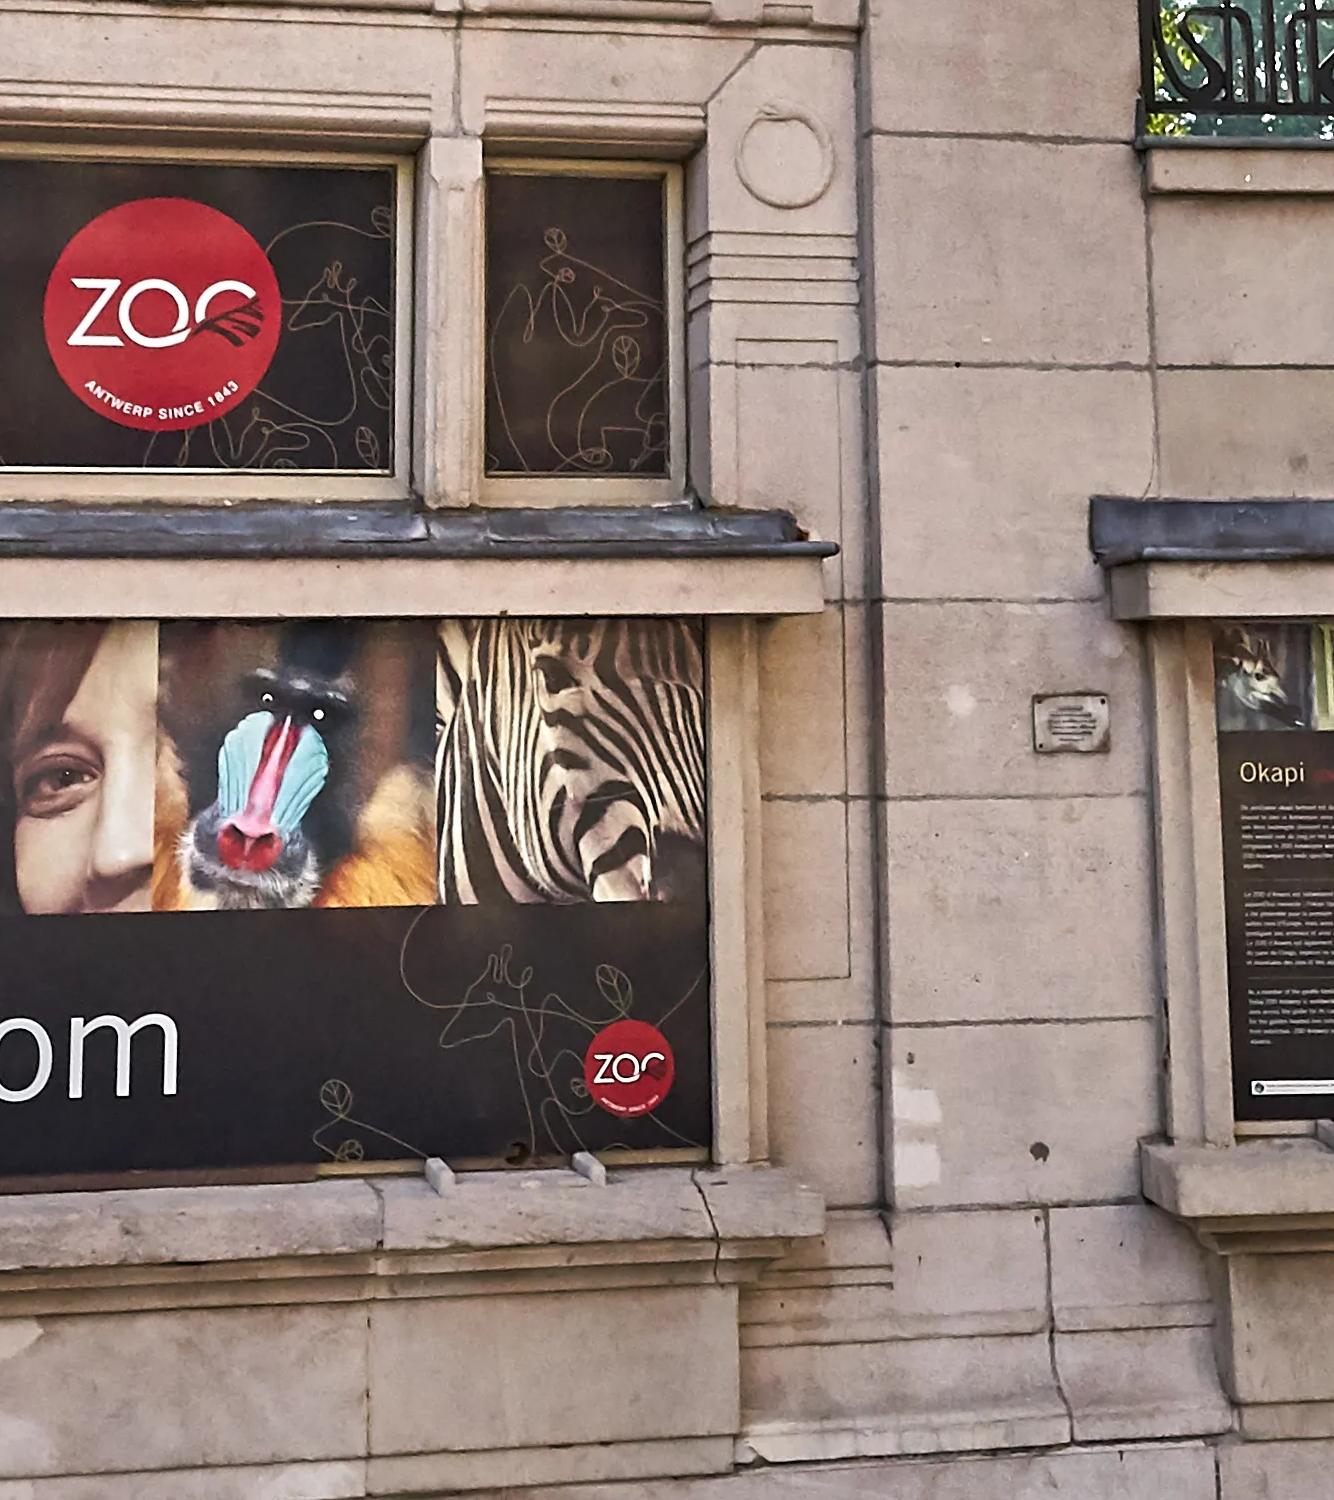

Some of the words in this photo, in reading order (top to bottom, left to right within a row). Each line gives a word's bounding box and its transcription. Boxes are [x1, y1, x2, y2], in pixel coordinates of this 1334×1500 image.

[84, 380, 153, 419] ANTWERP
[157, 401, 205, 420] SINCE
[207, 380, 240, 407] 1843
[1239, 761, 1304, 788] Okapi
